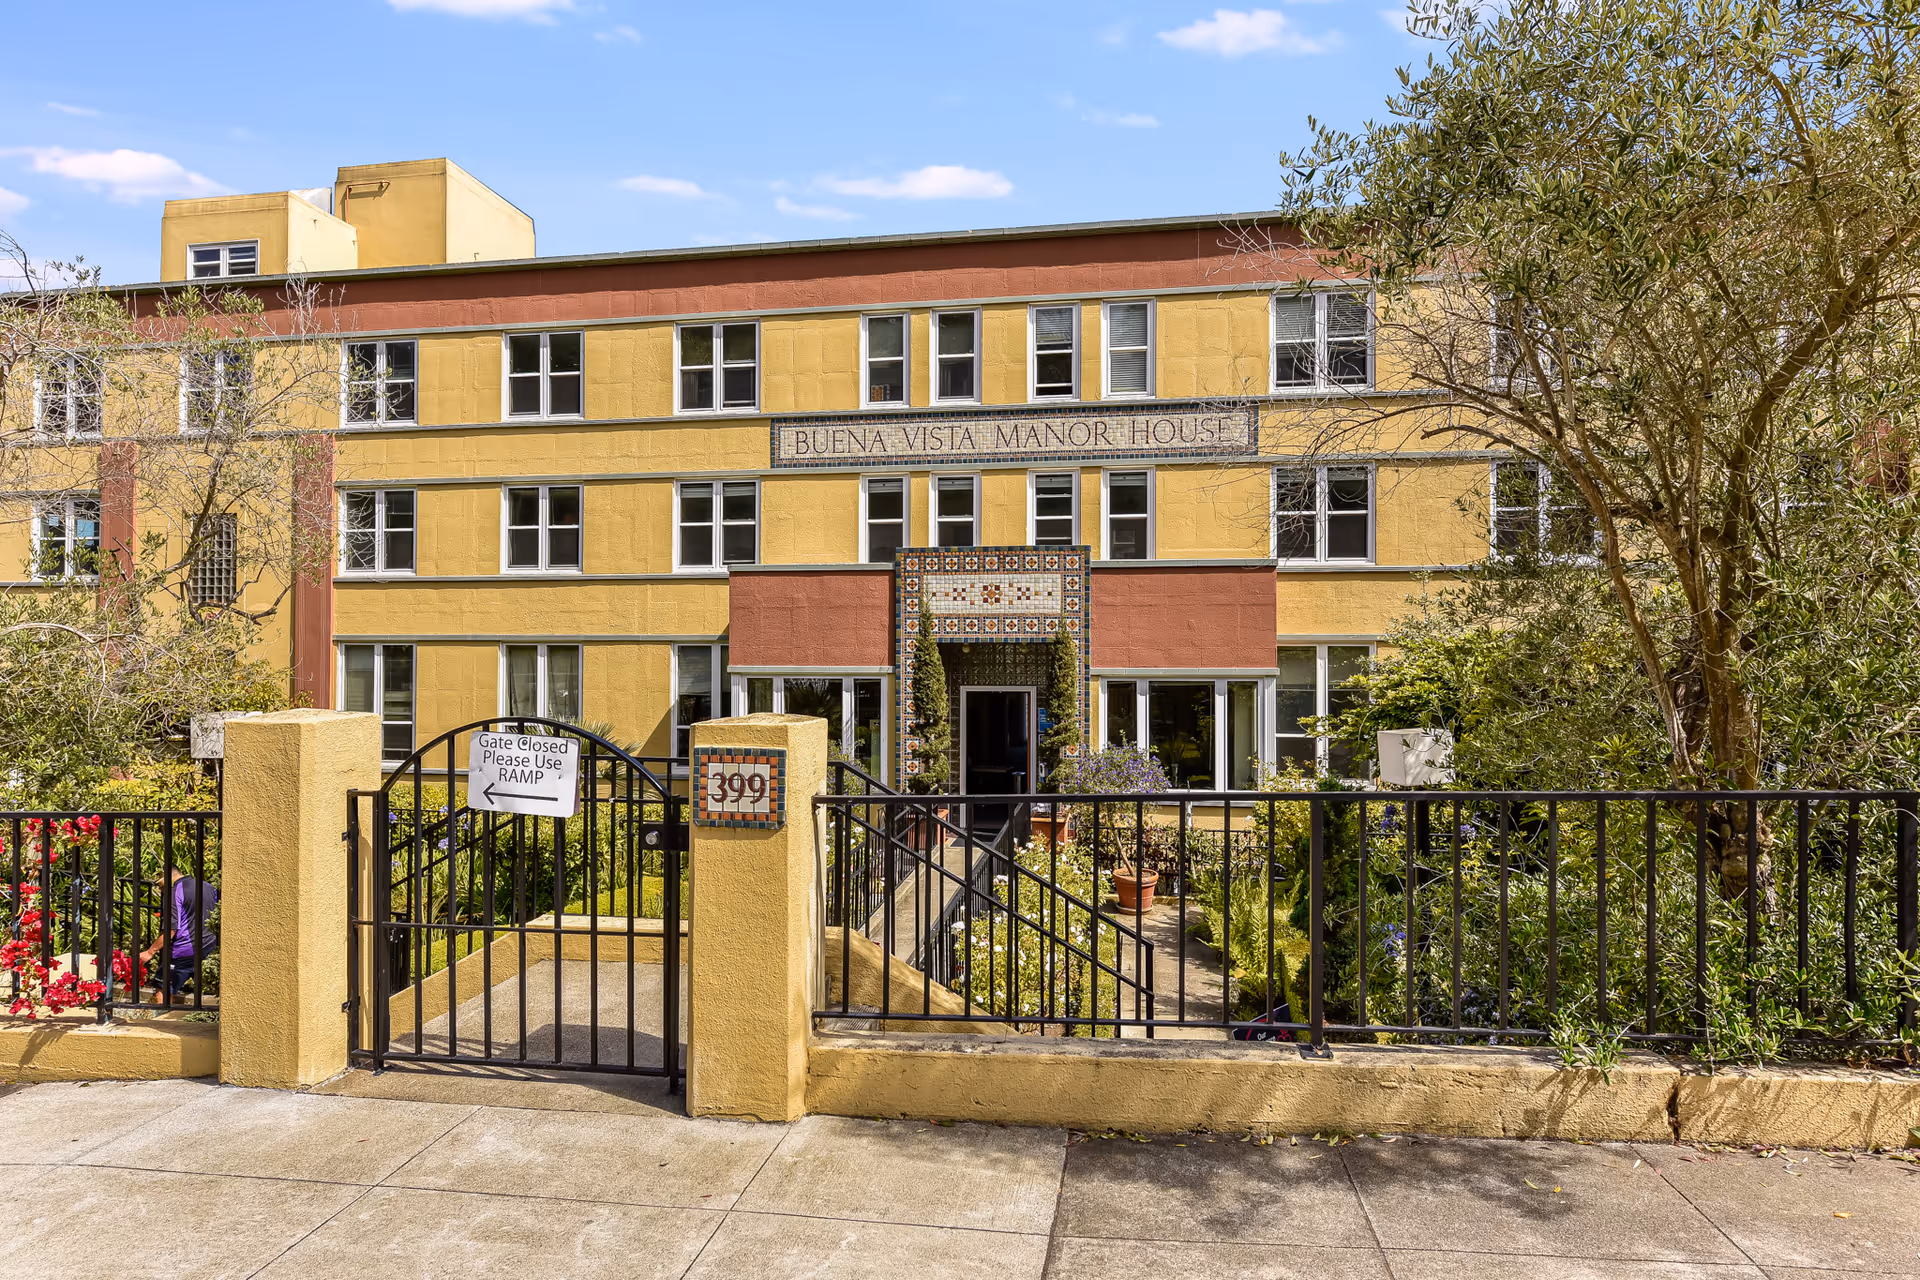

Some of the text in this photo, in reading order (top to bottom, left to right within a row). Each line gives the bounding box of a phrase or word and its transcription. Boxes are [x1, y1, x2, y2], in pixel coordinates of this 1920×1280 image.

[795, 416, 1233, 455] BUENA VISTA MANOR HOUSE
[478, 733, 568, 754] Gate Closed
[483, 750, 562, 770] Please Use
[498, 768, 544, 785] RAMP
[711, 772, 767, 804] 399
